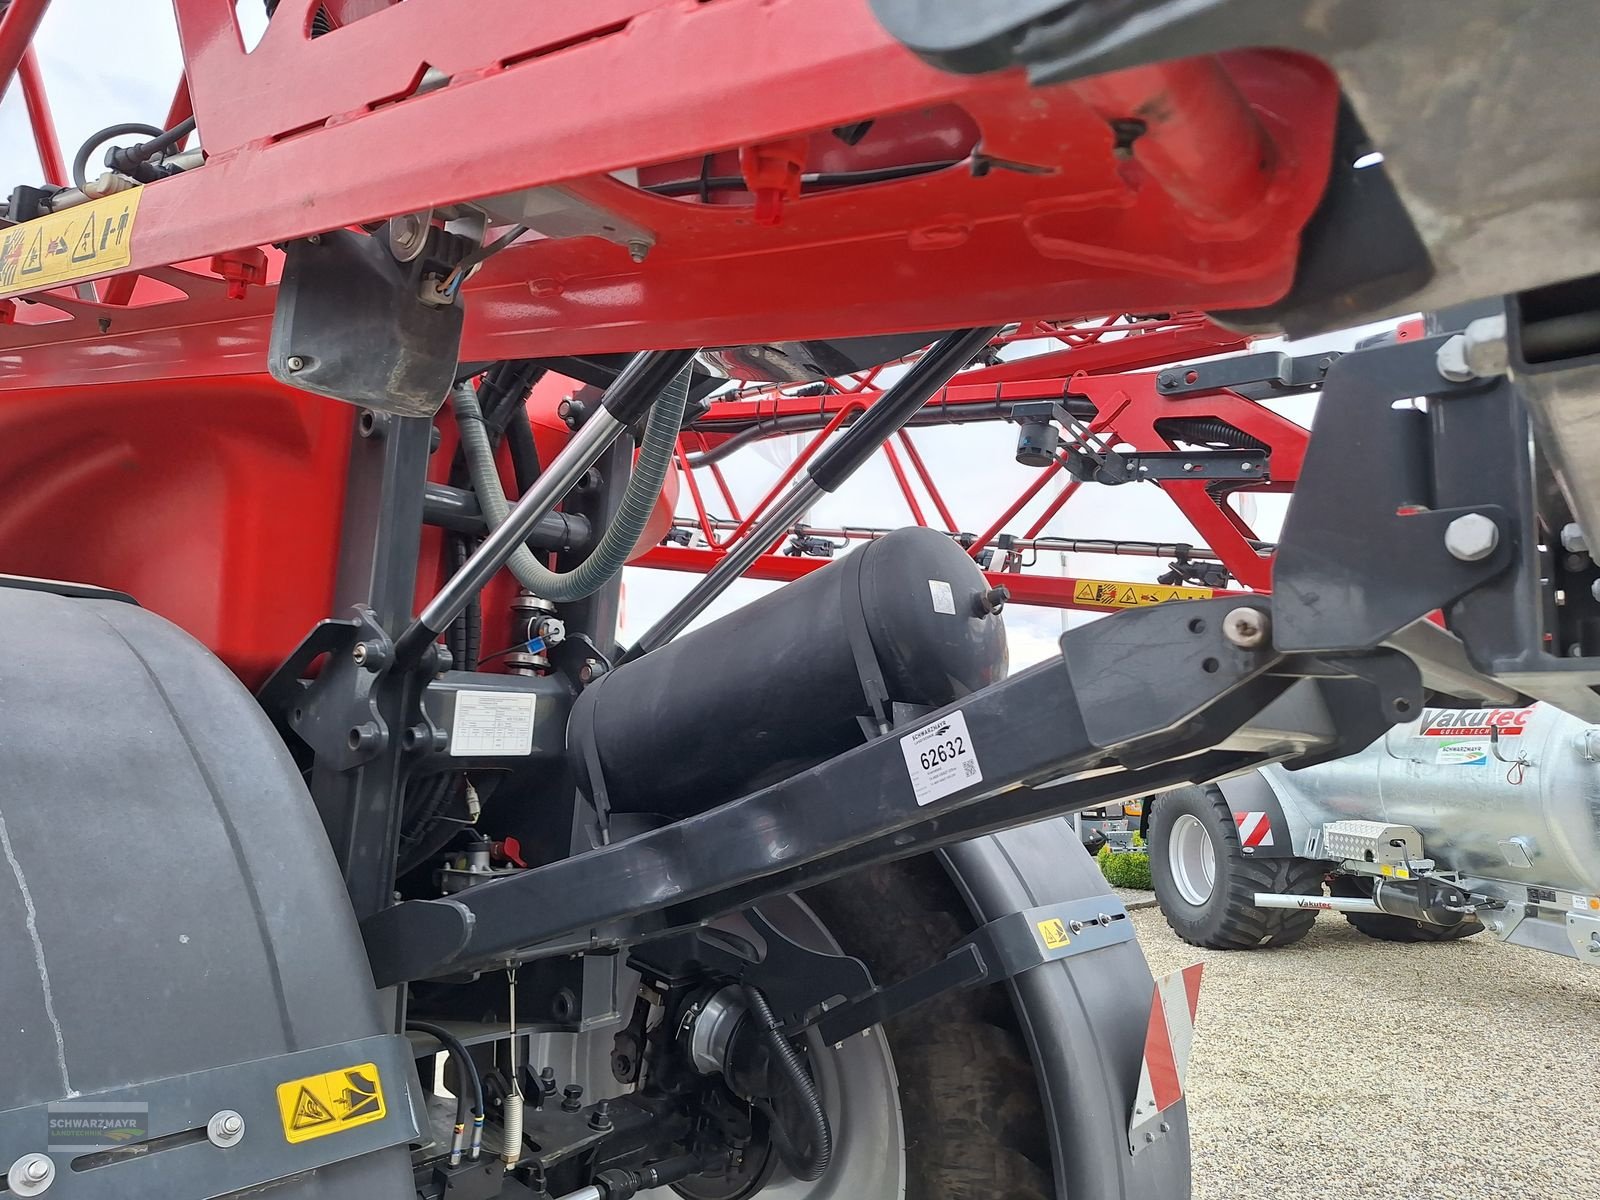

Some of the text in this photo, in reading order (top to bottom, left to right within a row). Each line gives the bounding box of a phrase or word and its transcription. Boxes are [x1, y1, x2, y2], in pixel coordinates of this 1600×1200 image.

[1419, 708, 1533, 735] Vakutec
[920, 736, 966, 770] 62632
[1297, 898, 1332, 909] Vakutec
